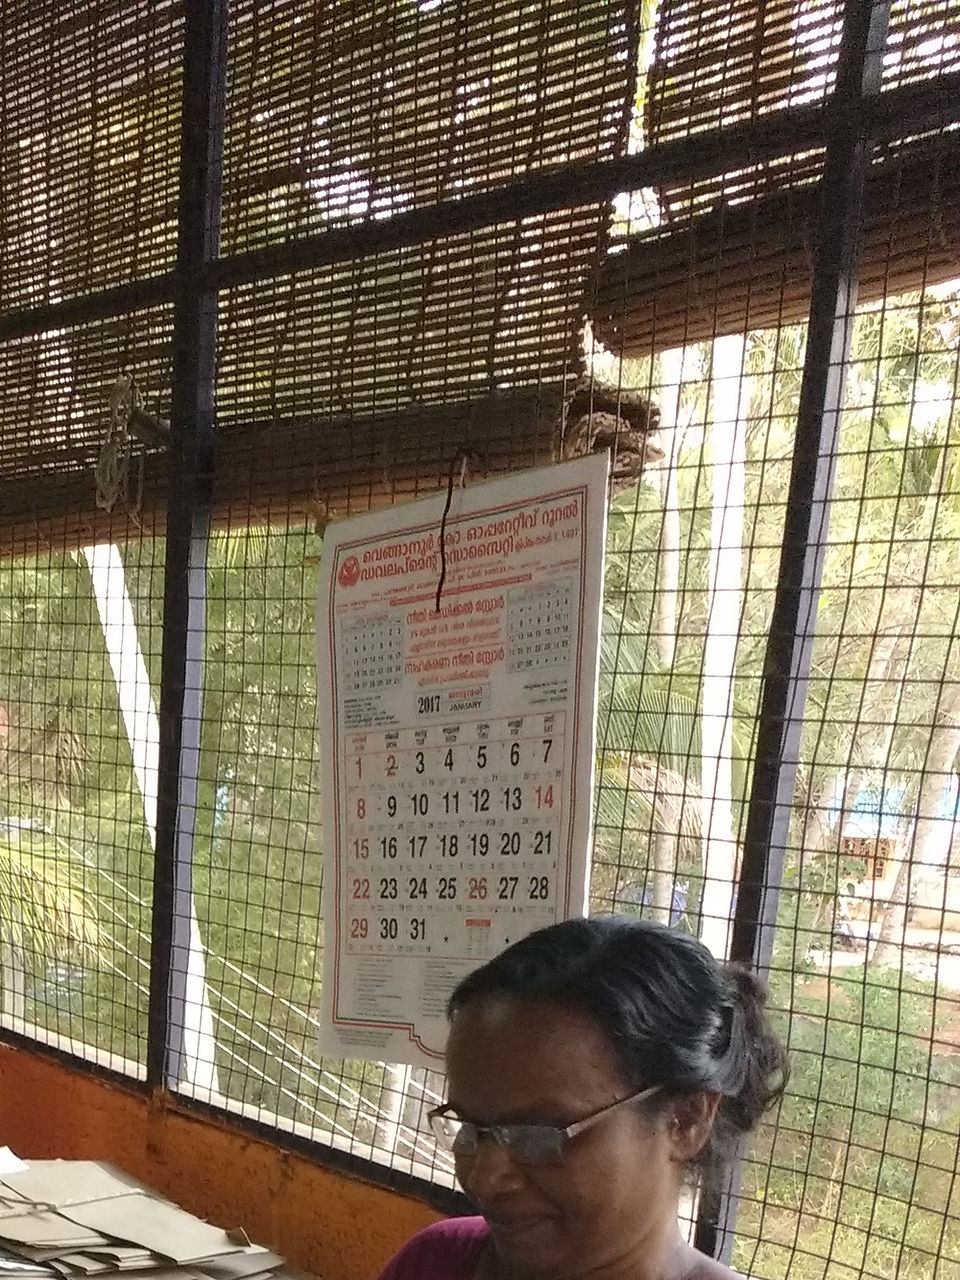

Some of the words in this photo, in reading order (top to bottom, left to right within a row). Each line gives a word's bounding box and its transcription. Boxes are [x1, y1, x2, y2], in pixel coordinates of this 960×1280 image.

[418, 695, 441, 714] 2017
[449, 701, 482, 711] JANUARY
[355, 757, 362, 779] 1
[386, 755, 396, 777] 2
[415, 752, 425, 774] 3
[444, 748, 454, 771] 4
[477, 746, 488, 769] 5
[510, 743, 520, 766] 6
[542, 739, 553, 763] 7
[357, 798, 365, 819] 8
[388, 795, 397, 817] 9
[411, 793, 429, 816] 10
[443, 791, 459, 814] 11
[472, 789, 490, 812] 12
[503, 787, 522, 811] 13
[535, 784, 553, 809] 14
[354, 838, 369, 859] 15
[381, 836, 397, 859] 16
[409, 836, 428, 858] 17
[440, 834, 458, 857] 18
[471, 833, 489, 856] 19
[500, 831, 521, 856] 20
[534, 830, 552, 855] 21
[352, 878, 370, 900] 22
[380, 878, 398, 900] 23
[409, 877, 428, 900] 24
[439, 876, 457, 900] 25
[469, 876, 488, 900] 26
[499, 876, 519, 900] 27
[530, 876, 549, 900] 28
[351, 918, 368, 939] 29
[380, 918, 398, 940] 30
[410, 918, 426, 940] 31
